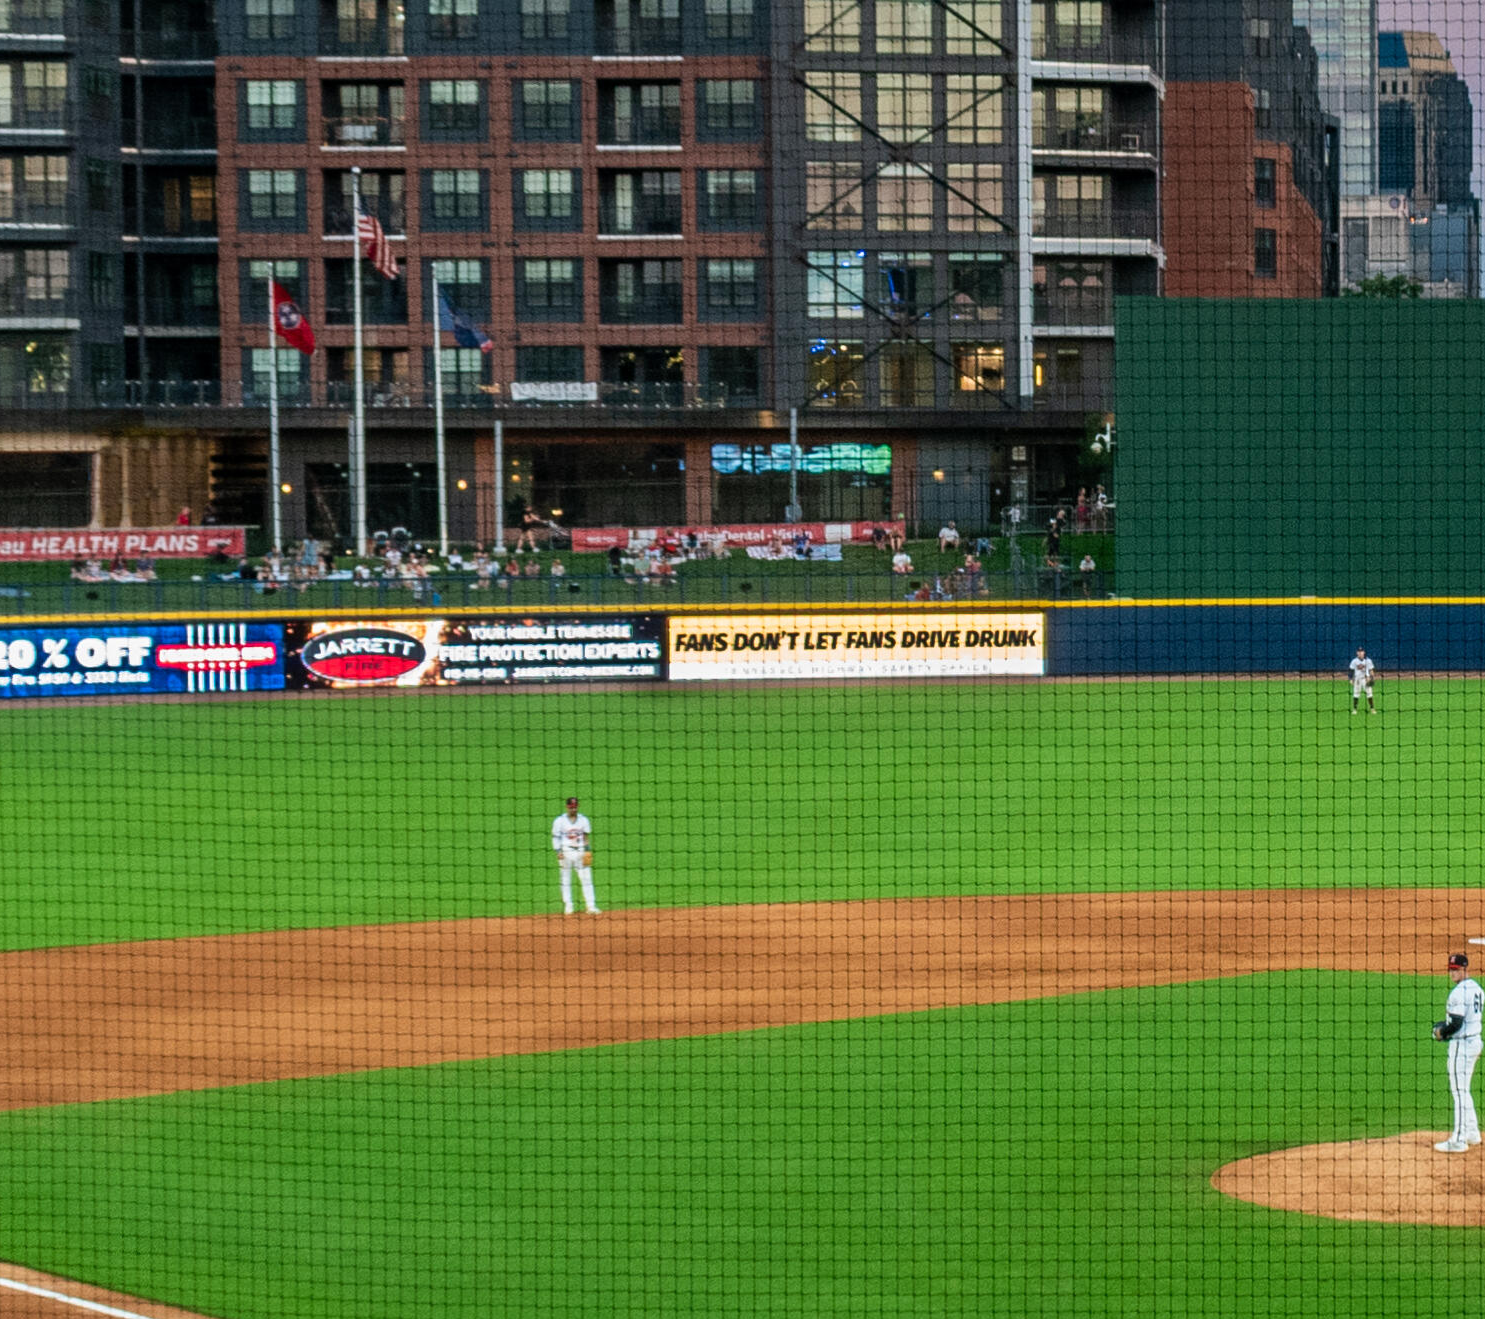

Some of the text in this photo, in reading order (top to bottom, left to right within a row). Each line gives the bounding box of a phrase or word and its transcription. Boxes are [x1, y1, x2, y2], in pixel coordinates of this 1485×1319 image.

[31, 536, 117, 555] HEALTH
[124, 534, 199, 553] PLANS
[469, 626, 506, 639] YOUR
[558, 625, 631, 638] TENNESSEE
[675, 629, 1037, 652] FANS DON'T LET FANS DRIVE DRUNK
[75, 636, 152, 668] OFF
[314, 637, 415, 660] JARRETT
[439, 642, 660, 661] FIRE PROTECTION EXPERTS
[345, 662, 383, 671] FIRE
